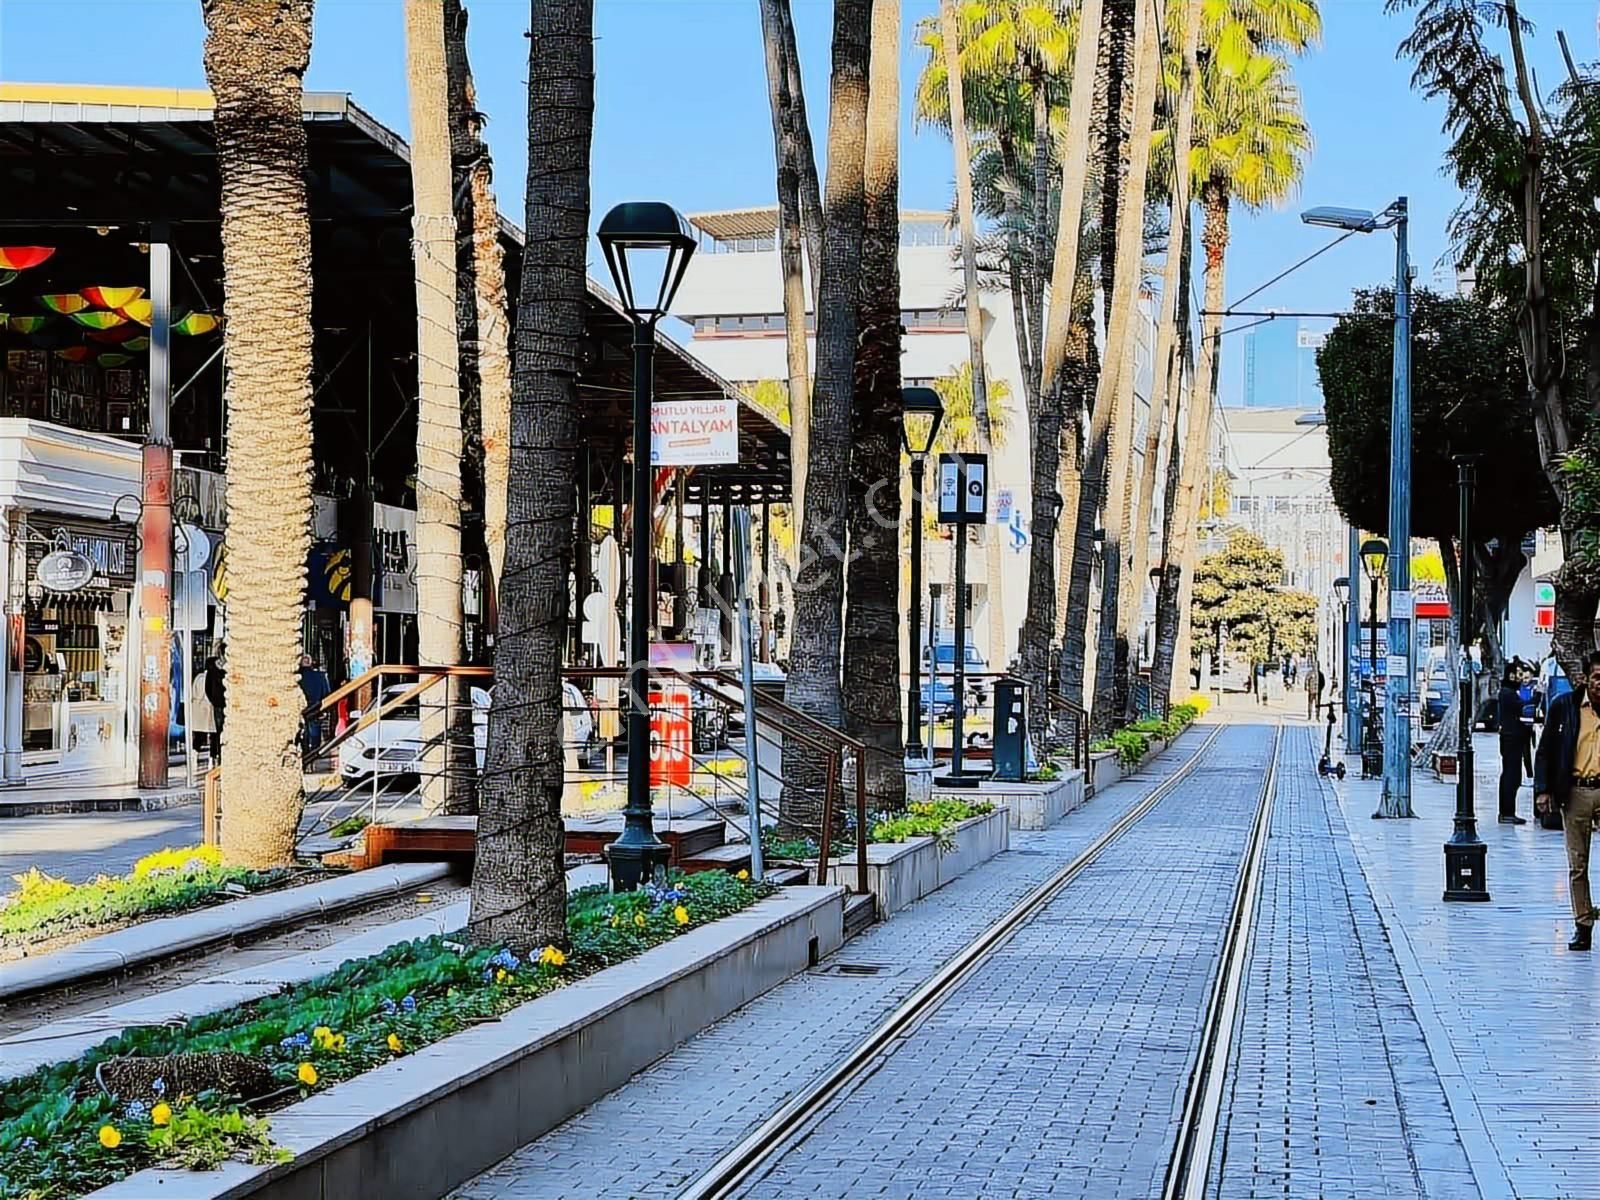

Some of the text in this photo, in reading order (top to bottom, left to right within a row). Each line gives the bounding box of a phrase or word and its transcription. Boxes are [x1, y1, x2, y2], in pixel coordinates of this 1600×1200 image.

[651, 405, 726, 416] MUTLU YILLAR
[651, 419, 733, 434] ANTALYAM
